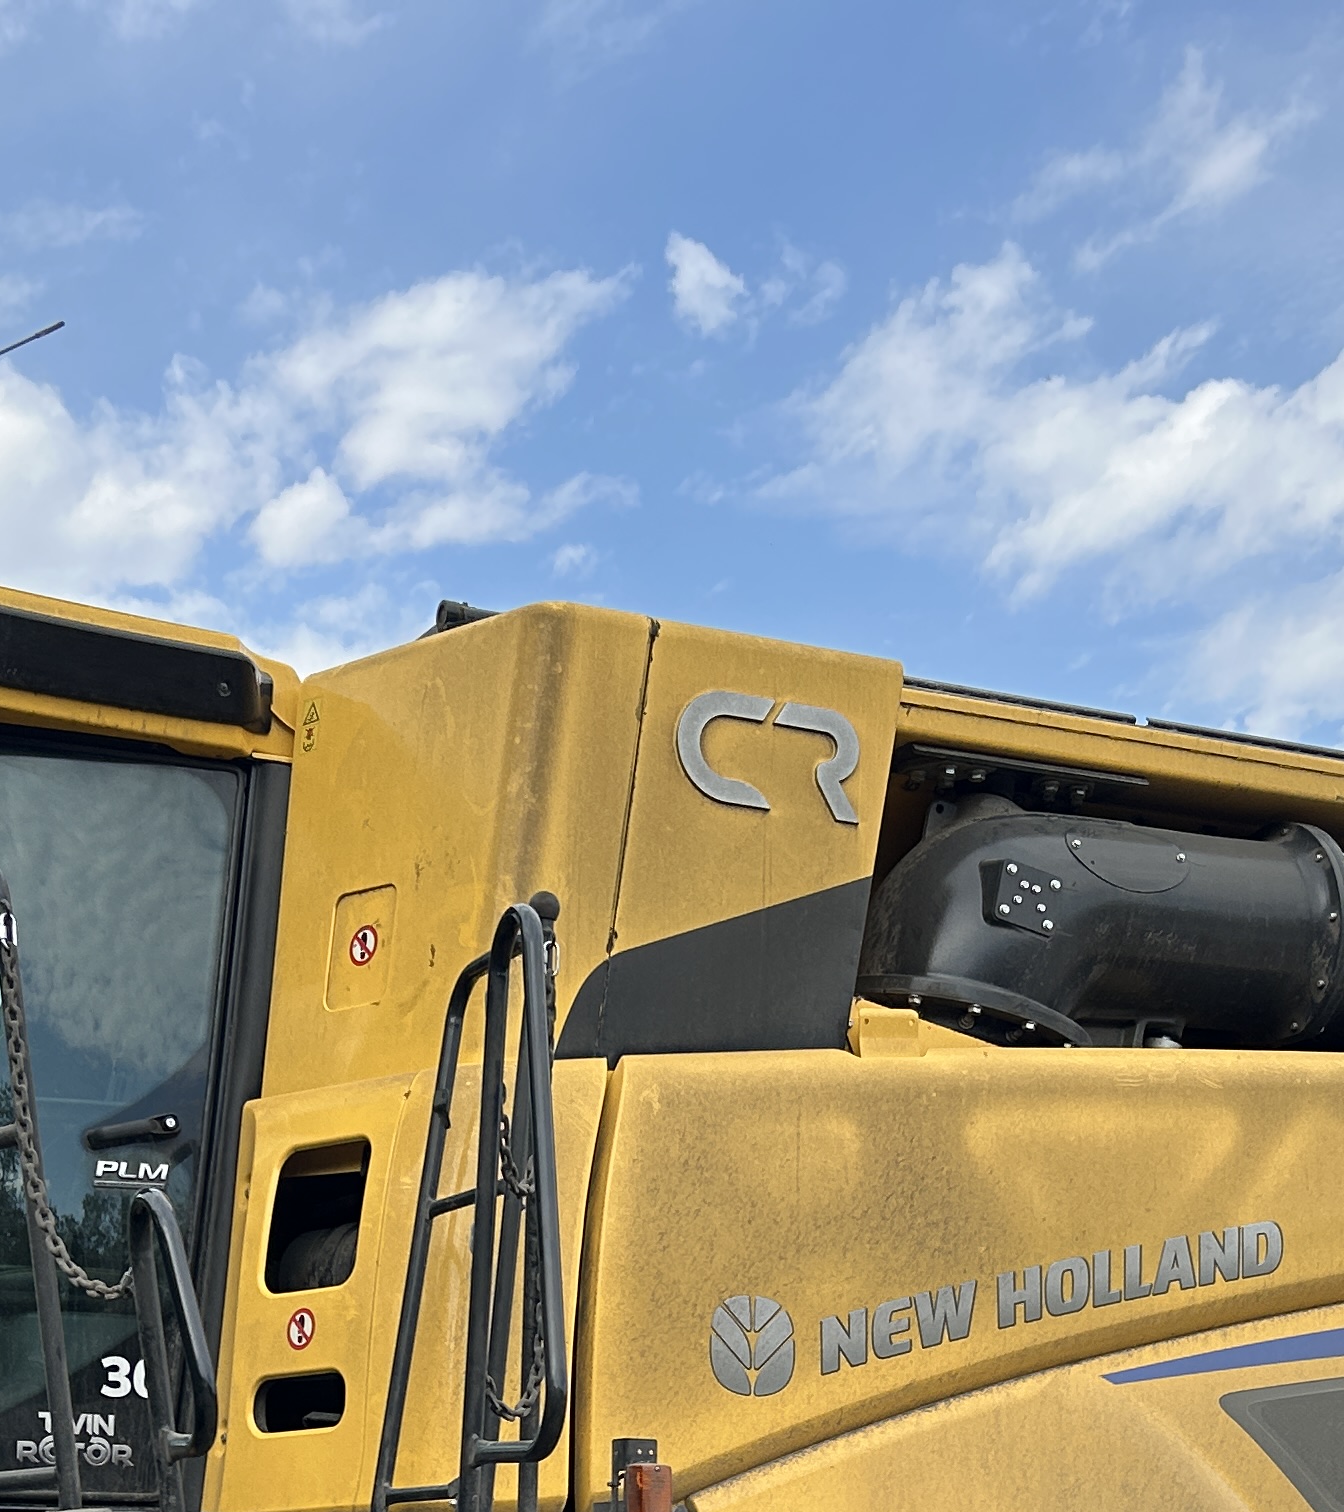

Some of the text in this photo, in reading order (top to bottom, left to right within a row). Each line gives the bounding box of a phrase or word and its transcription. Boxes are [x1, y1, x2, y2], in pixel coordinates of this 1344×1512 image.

[676, 689, 860, 826] CR
[94, 1160, 170, 1181] PLM
[819, 1219, 1285, 1377] NEW HOLLAND
